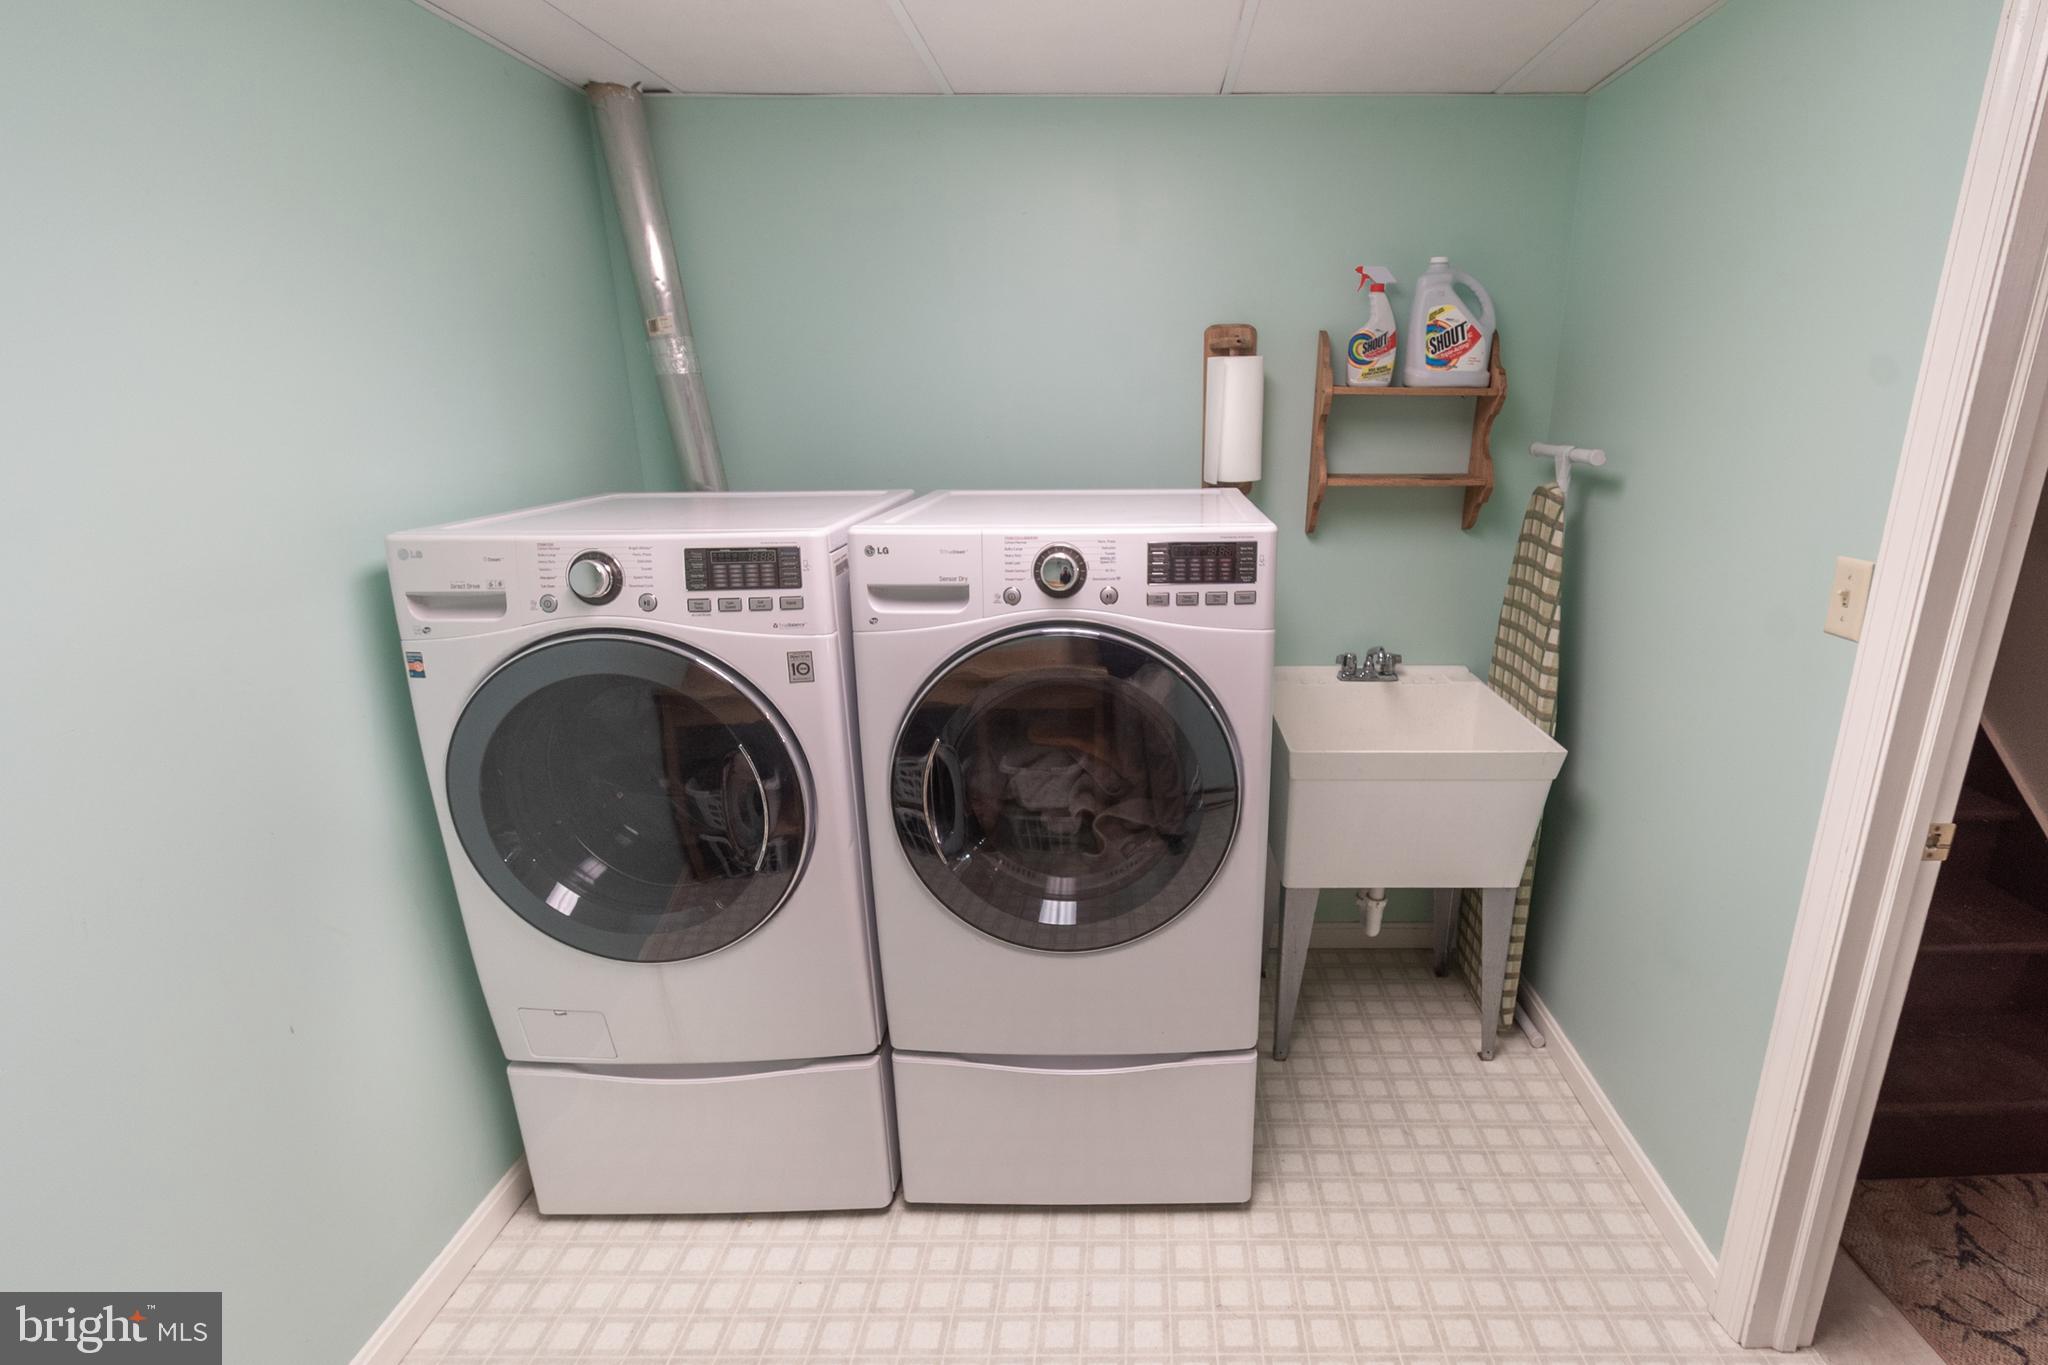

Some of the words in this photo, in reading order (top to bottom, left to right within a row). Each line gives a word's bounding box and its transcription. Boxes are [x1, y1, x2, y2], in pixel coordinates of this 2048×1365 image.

[1362, 331, 1389, 354] SHOUT
[1429, 320, 1467, 354] SHOUT
[877, 546, 889, 555] LG
[791, 662, 811, 676] 10
